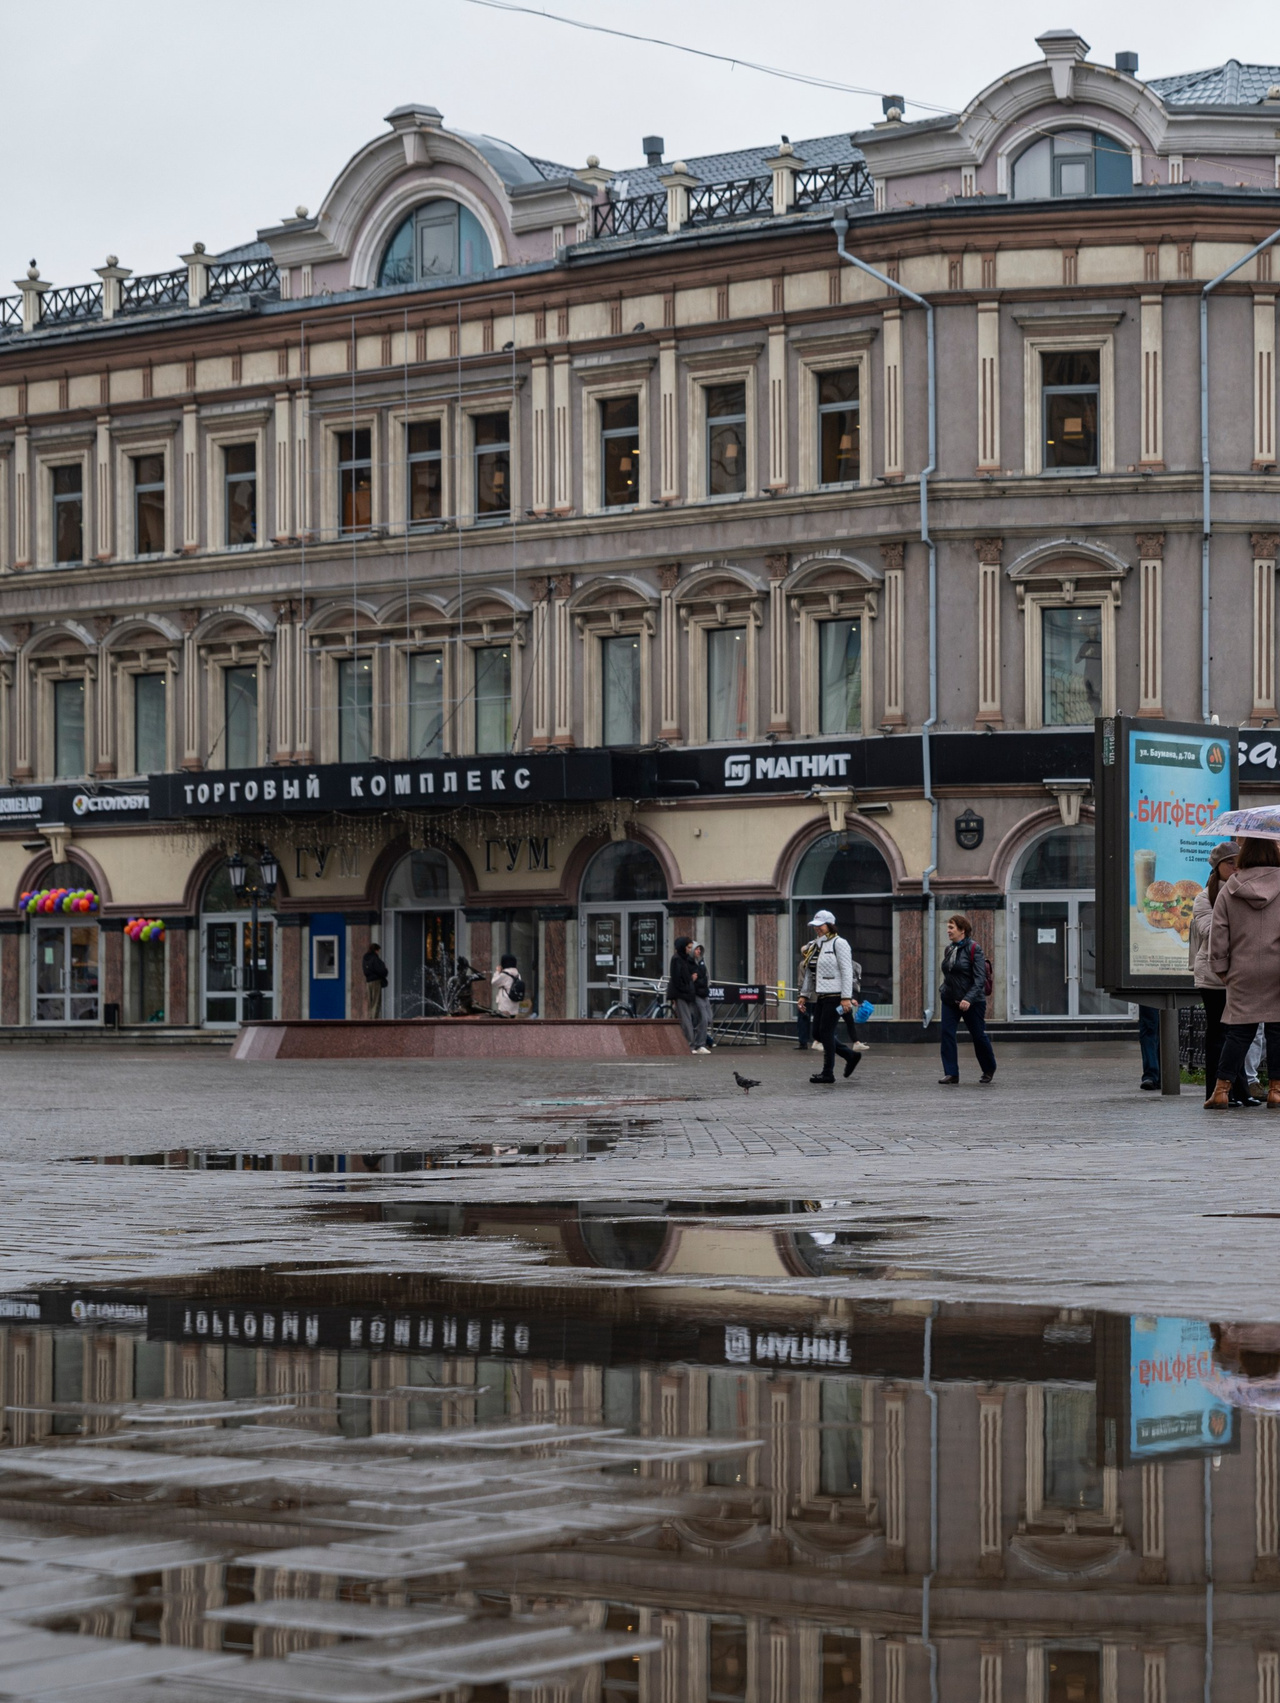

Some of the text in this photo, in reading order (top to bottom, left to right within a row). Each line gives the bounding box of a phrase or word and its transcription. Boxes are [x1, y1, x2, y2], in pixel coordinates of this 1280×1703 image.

[756, 753, 851, 780] МАГНИТ
[1140, 749, 1149, 757] ул.
[184, 767, 531, 804] ТОРГОВЫЙ КОМПЛЕКС
[1138, 799, 1217, 828] БИГФЕСТ
[295, 844, 361, 879] ГУМ
[485, 836, 553, 873] ГУМ
